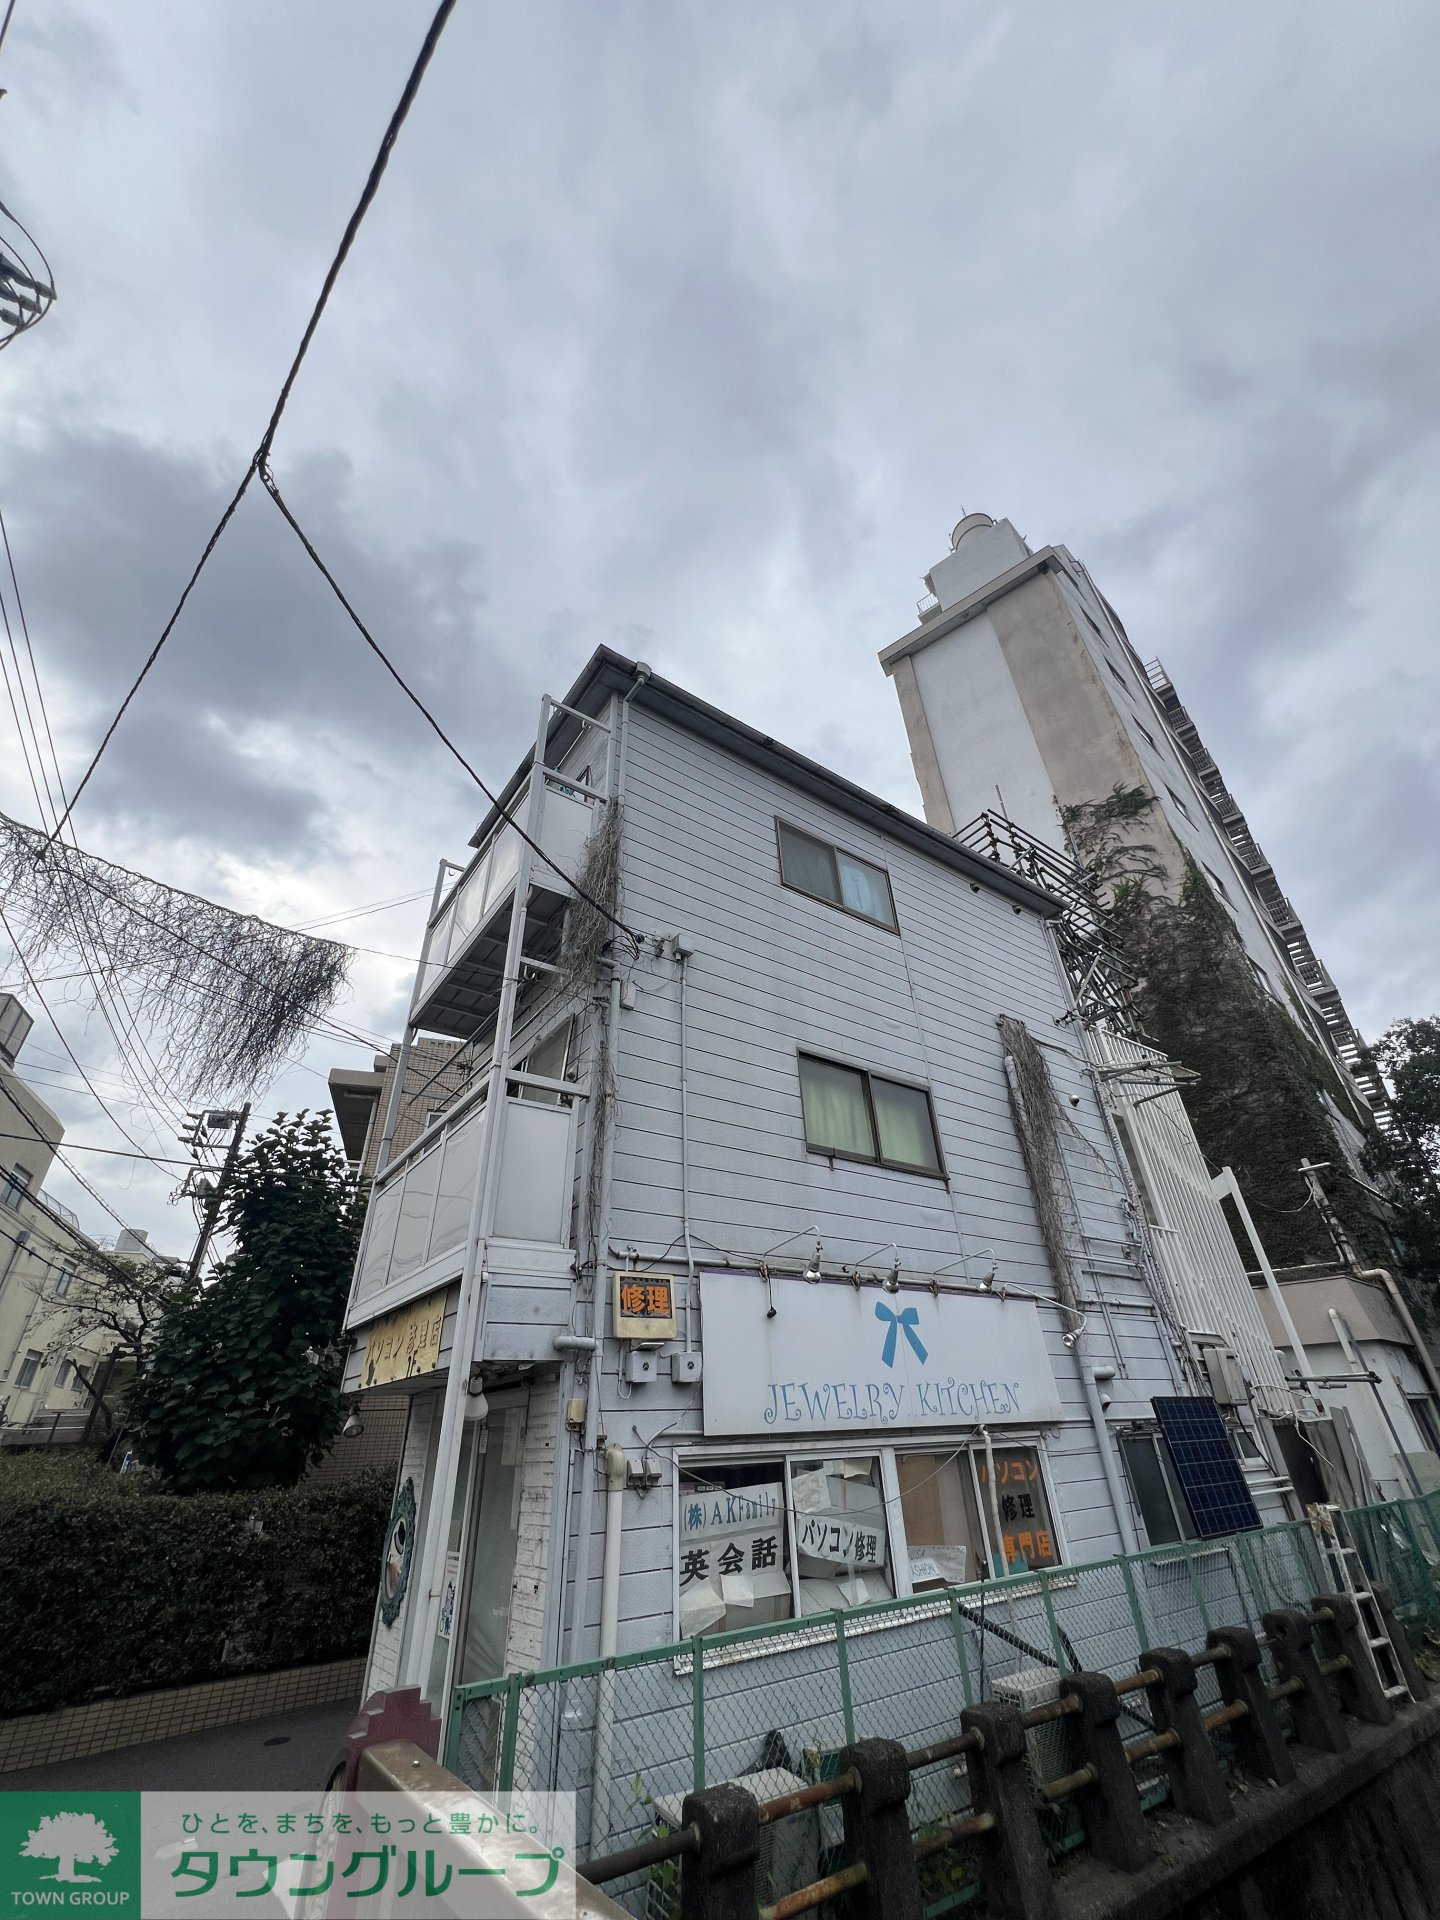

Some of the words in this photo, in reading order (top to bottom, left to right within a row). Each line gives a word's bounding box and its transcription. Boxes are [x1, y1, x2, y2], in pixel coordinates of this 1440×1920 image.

[621, 1284, 670, 1314] 修理
[763, 1382, 905, 1425] JEWELRY
[916, 1376, 1022, 1422] KITCHEN
[1001, 1493, 1036, 1522] 修理
[679, 1535, 778, 1587] 英会話
[802, 1519, 878, 1564] パソコン修理
